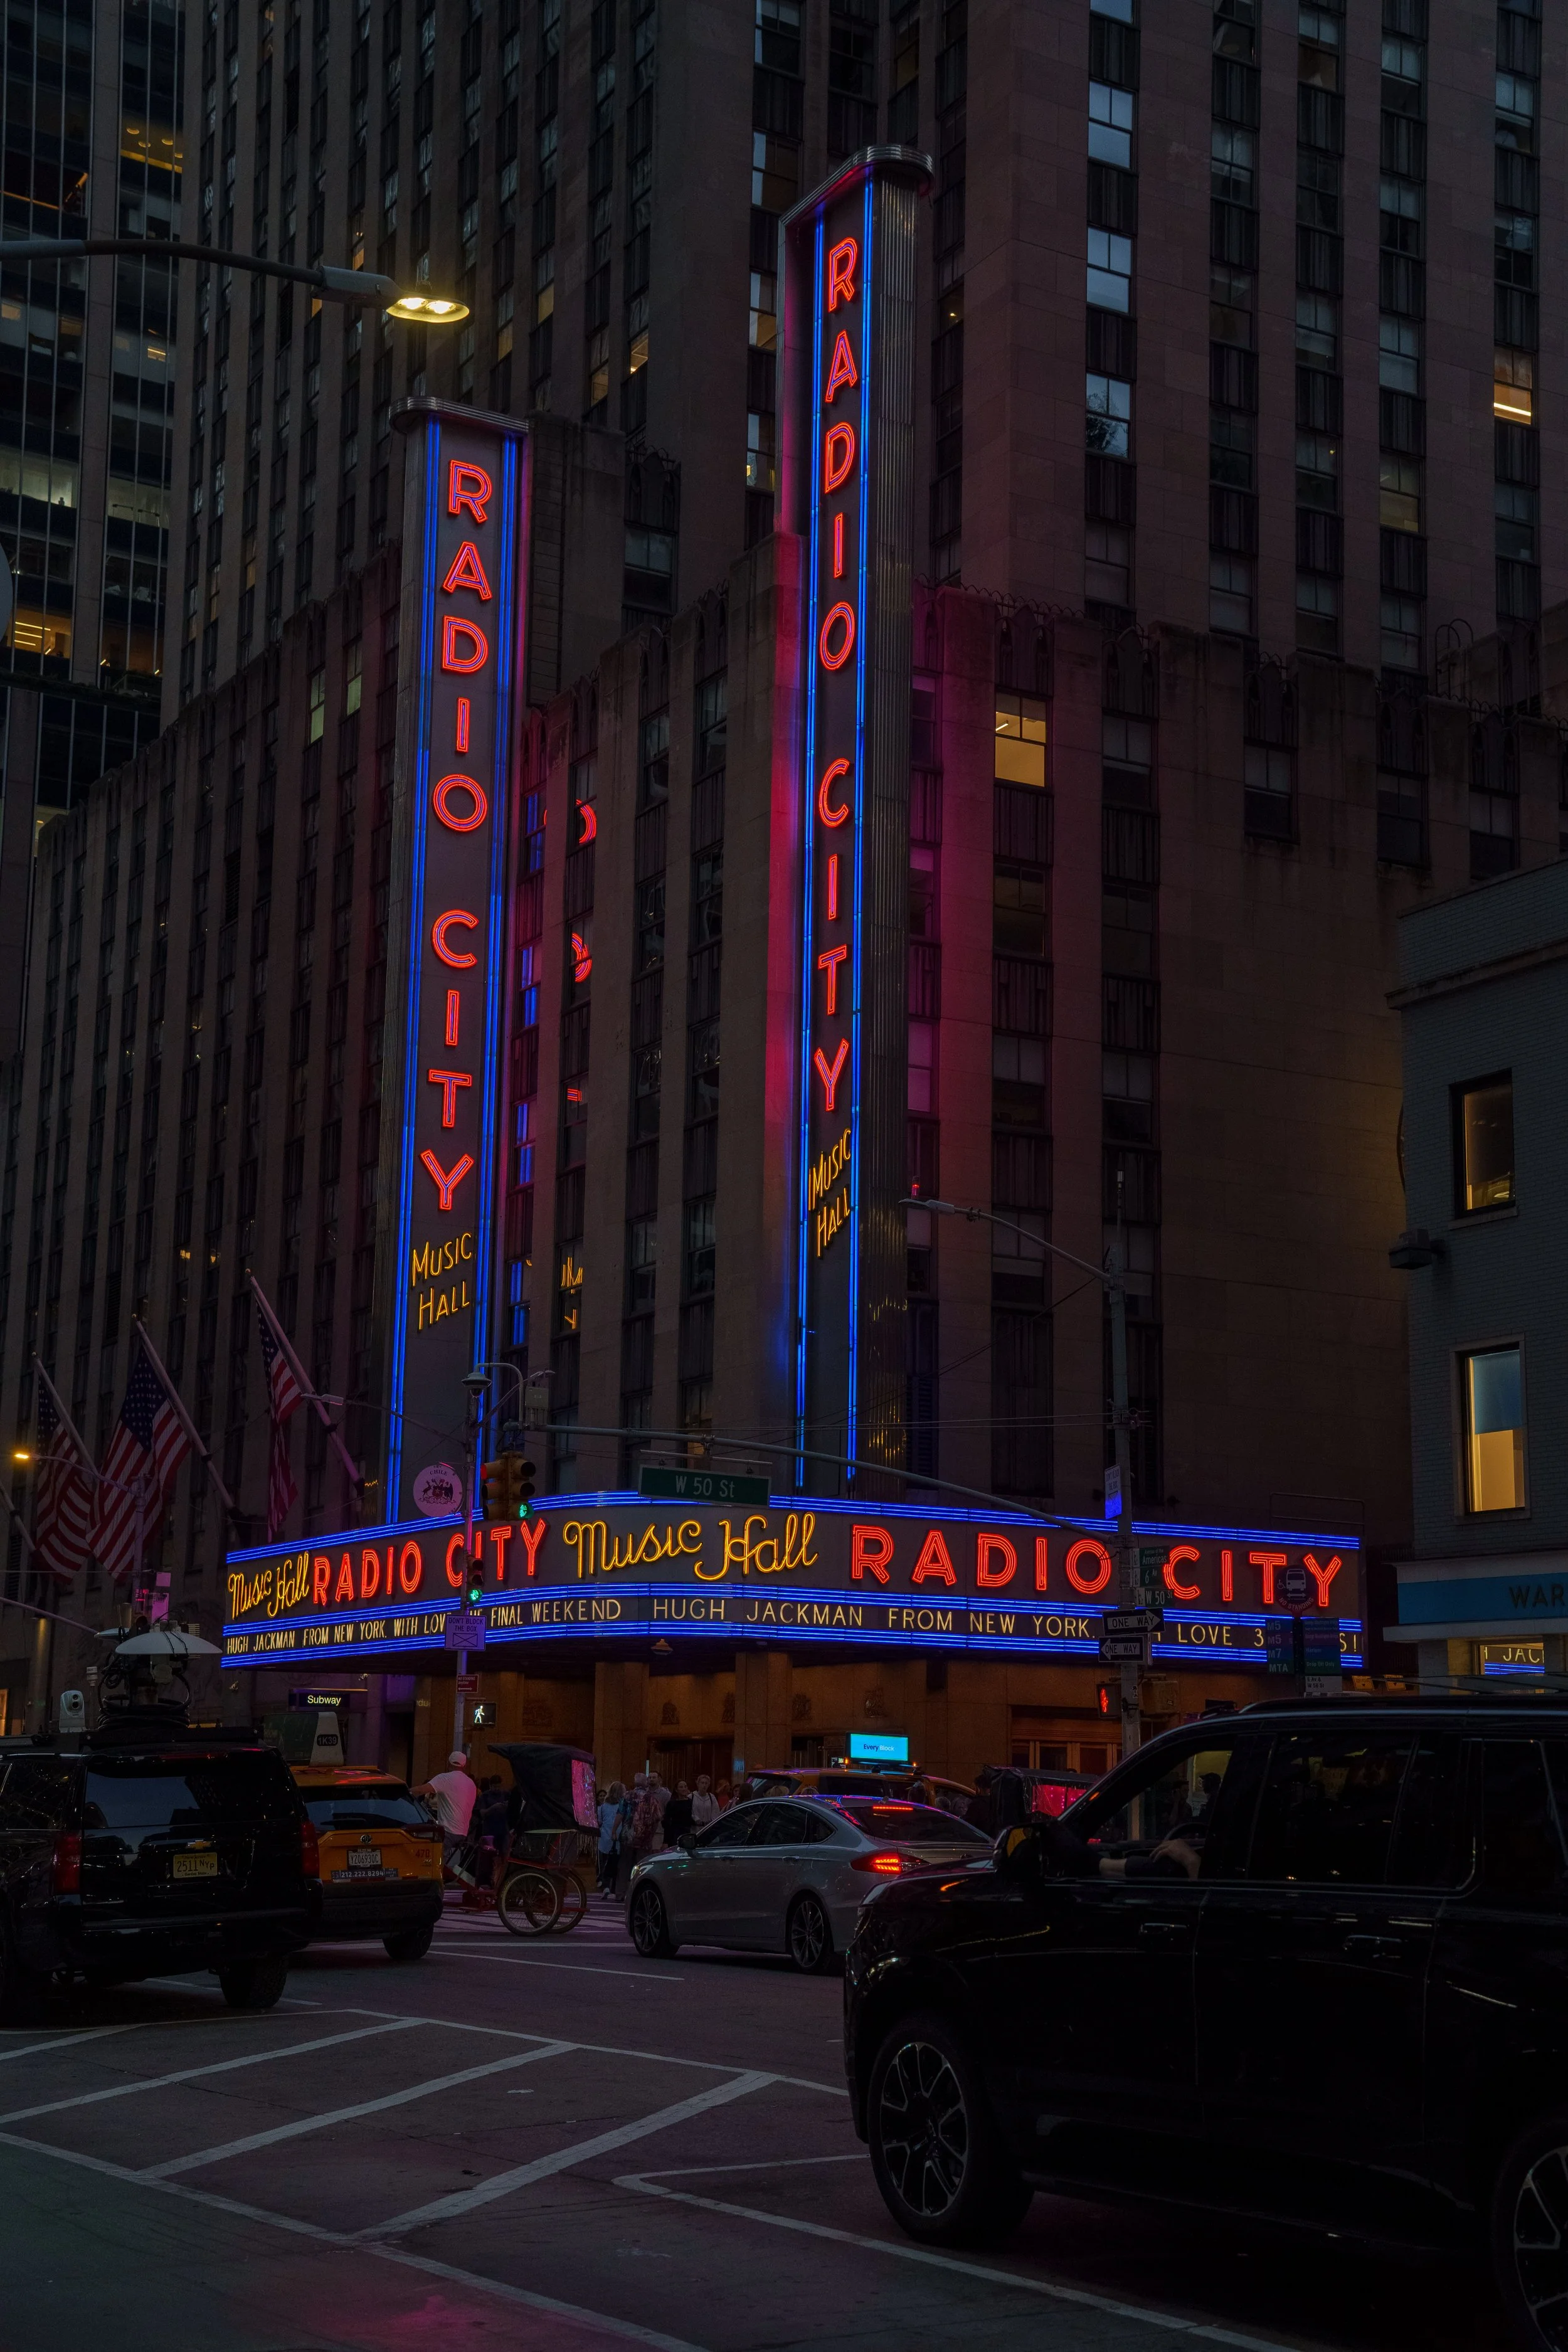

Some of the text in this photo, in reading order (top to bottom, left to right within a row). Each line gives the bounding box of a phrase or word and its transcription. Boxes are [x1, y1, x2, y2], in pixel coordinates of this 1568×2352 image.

[813, 236, 857, 1111] RADIO CITY
[419, 460, 492, 1210] RADIO CITY
[817, 1187, 850, 1258] HALL
[411, 1232, 473, 1287] MUSIC
[418, 1280, 470, 1331] HALL
[675, 1475, 735, 1498] W 50 St
[563, 1512, 1343, 1608] Music Hall RADIO CITY
[1142, 1555, 1167, 1565] Americas
[228, 1569, 272, 1620] Music
[267, 1550, 310, 1618] Hall
[314, 1540, 422, 1606] RADIO
[1145, 1570, 1150, 1584] 6
[1146, 1591, 1173, 1604] W 50 St
[1279, 1597, 1314, 1611] NO STANDING
[490, 1599, 621, 1628] FINAL WEEKEND
[654, 1598, 725, 1621] HUGH
[746, 1602, 863, 1626] JACKMAN
[888, 1608, 953, 1631] FROM
[970, 1612, 1015, 1634] NEW
[1112, 1616, 1154, 1628] ONE WAY
[1267, 1621, 1281, 1630] M5
[227, 1636, 248, 1655] HUGH
[253, 1631, 295, 1651] JACKMAN
[303, 1627, 329, 1648] FROM
[334, 1623, 354, 1644] NEW
[393, 1616, 419, 1637] WITH
[423, 1613, 452, 1634] LOV
[1177, 1623, 1232, 1646] LOVE
[1254, 1628, 1264, 1646] 3
[1268, 1634, 1281, 1645] M5
[1105, 1644, 1136, 1653] ONE WAY
[1268, 1648, 1281, 1658] M7
[1269, 1663, 1288, 1673] MTA
[307, 1695, 341, 1707] Subway
[318, 1736, 337, 1744] 1K39
[863, 1744, 879, 1752] Every
[415, 1848, 430, 1858] 470
